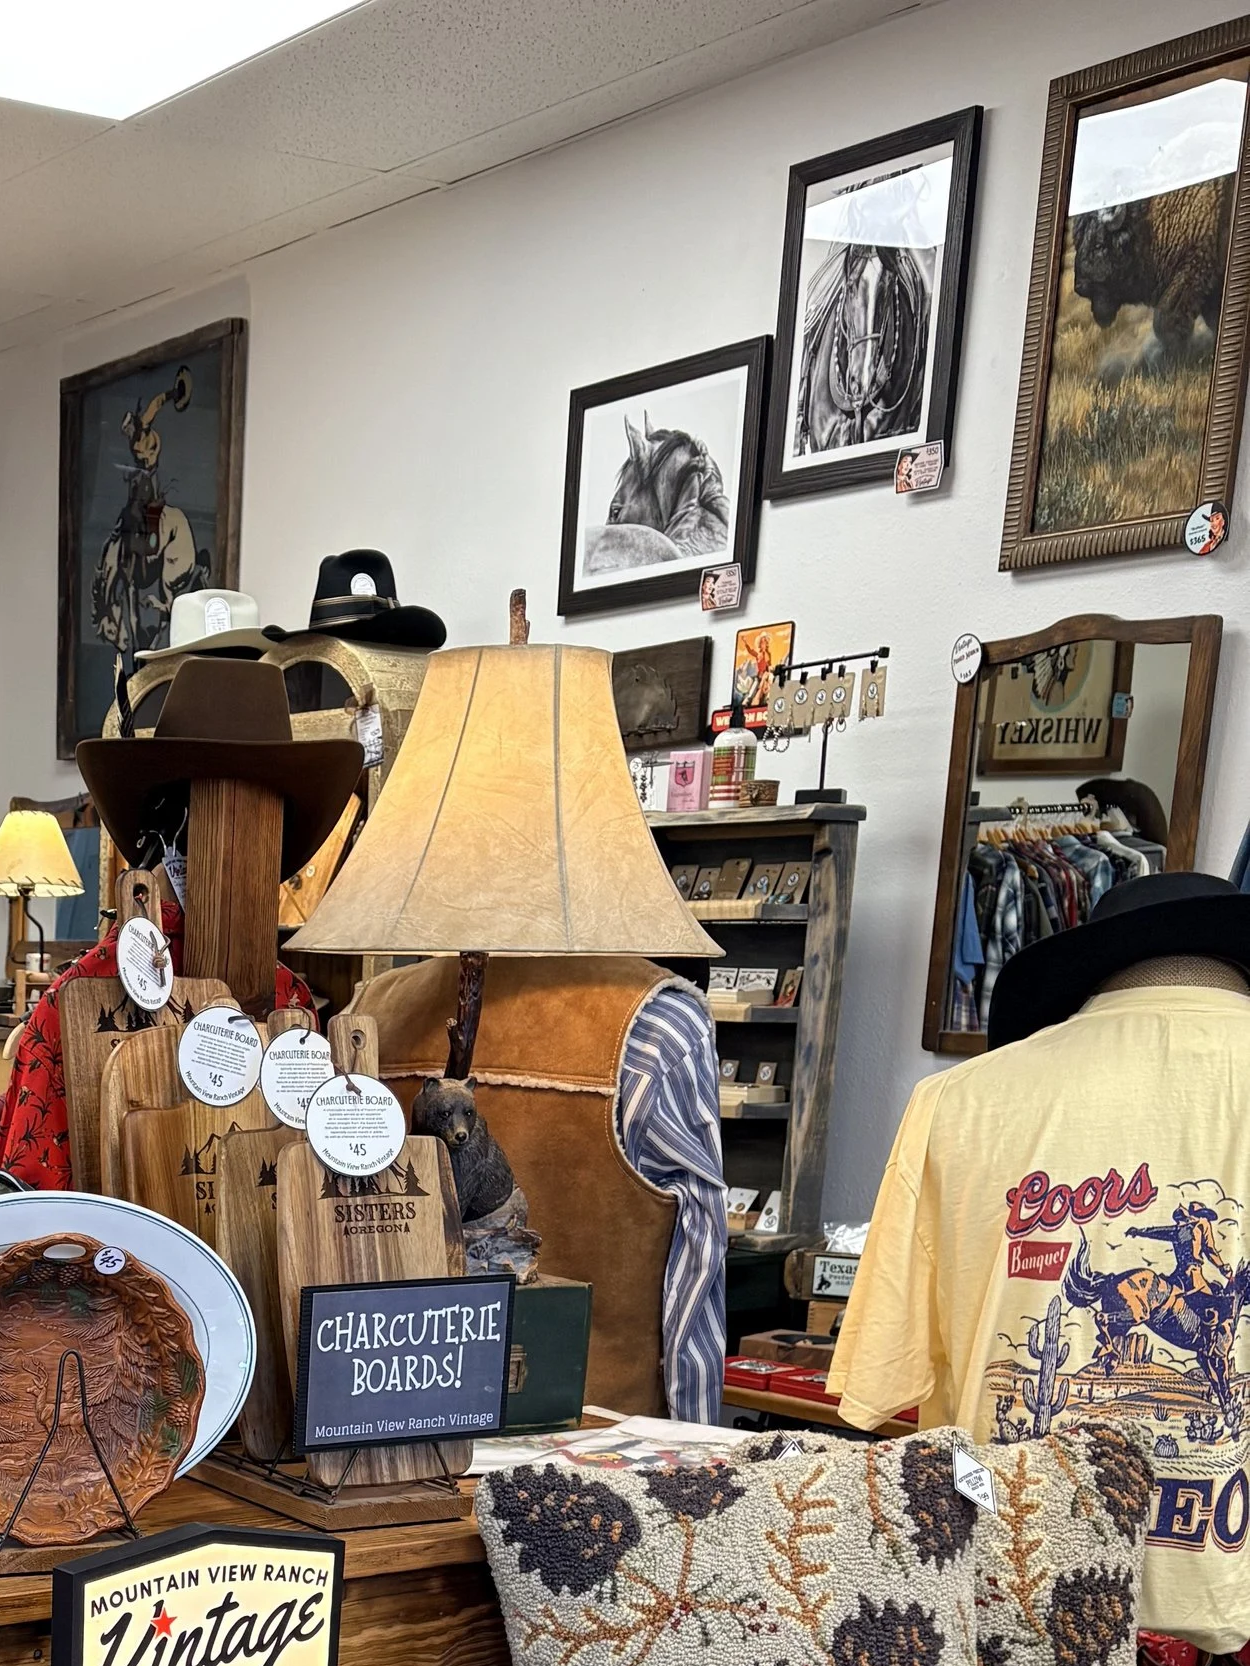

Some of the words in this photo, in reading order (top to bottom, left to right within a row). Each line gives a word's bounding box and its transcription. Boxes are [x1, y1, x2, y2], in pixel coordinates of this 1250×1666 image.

[1190, 534, 1206, 546] $365
[137, 974, 147, 991] $45
[193, 1021, 235, 1039] CHARCUTERIE
[235, 1032, 259, 1047] BOARD
[269, 1050, 310, 1060] CHARCUTERIE
[311, 1050, 330, 1060] BOAR
[185, 1070, 203, 1094] Mountain
[202, 1088, 213, 1099] View
[209, 1072, 224, 1087] $45
[316, 1095, 364, 1106] CHARCUTERIE
[365, 1095, 393, 1106] BOARD
[274, 1102, 295, 1122] Mountain
[322, 1148, 346, 1168] Mountain
[361, 1162, 378, 1170] Ranch
[376, 1148, 394, 1165] Vintage
[349, 1143, 367, 1156] $45
[335, 1201, 417, 1223] SISTERS
[1005, 1163, 1158, 1240] Coors
[350, 1224, 403, 1235] OREGON
[102, 1249, 123, 1268] $45
[1011, 1240, 1067, 1275] Banquet
[316, 1301, 501, 1353] CHARCUTERIE
[351, 1345, 463, 1395] BOARDS!
[315, 1422, 373, 1438] Mountain
[377, 1419, 405, 1433] View
[408, 1415, 445, 1430] Ranch
[449, 1412, 494, 1427] Vintage
[90, 1569, 199, 1618] MOUNTAIN
[207, 1564, 257, 1586] VIEW
[263, 1564, 329, 1587] RANCH
